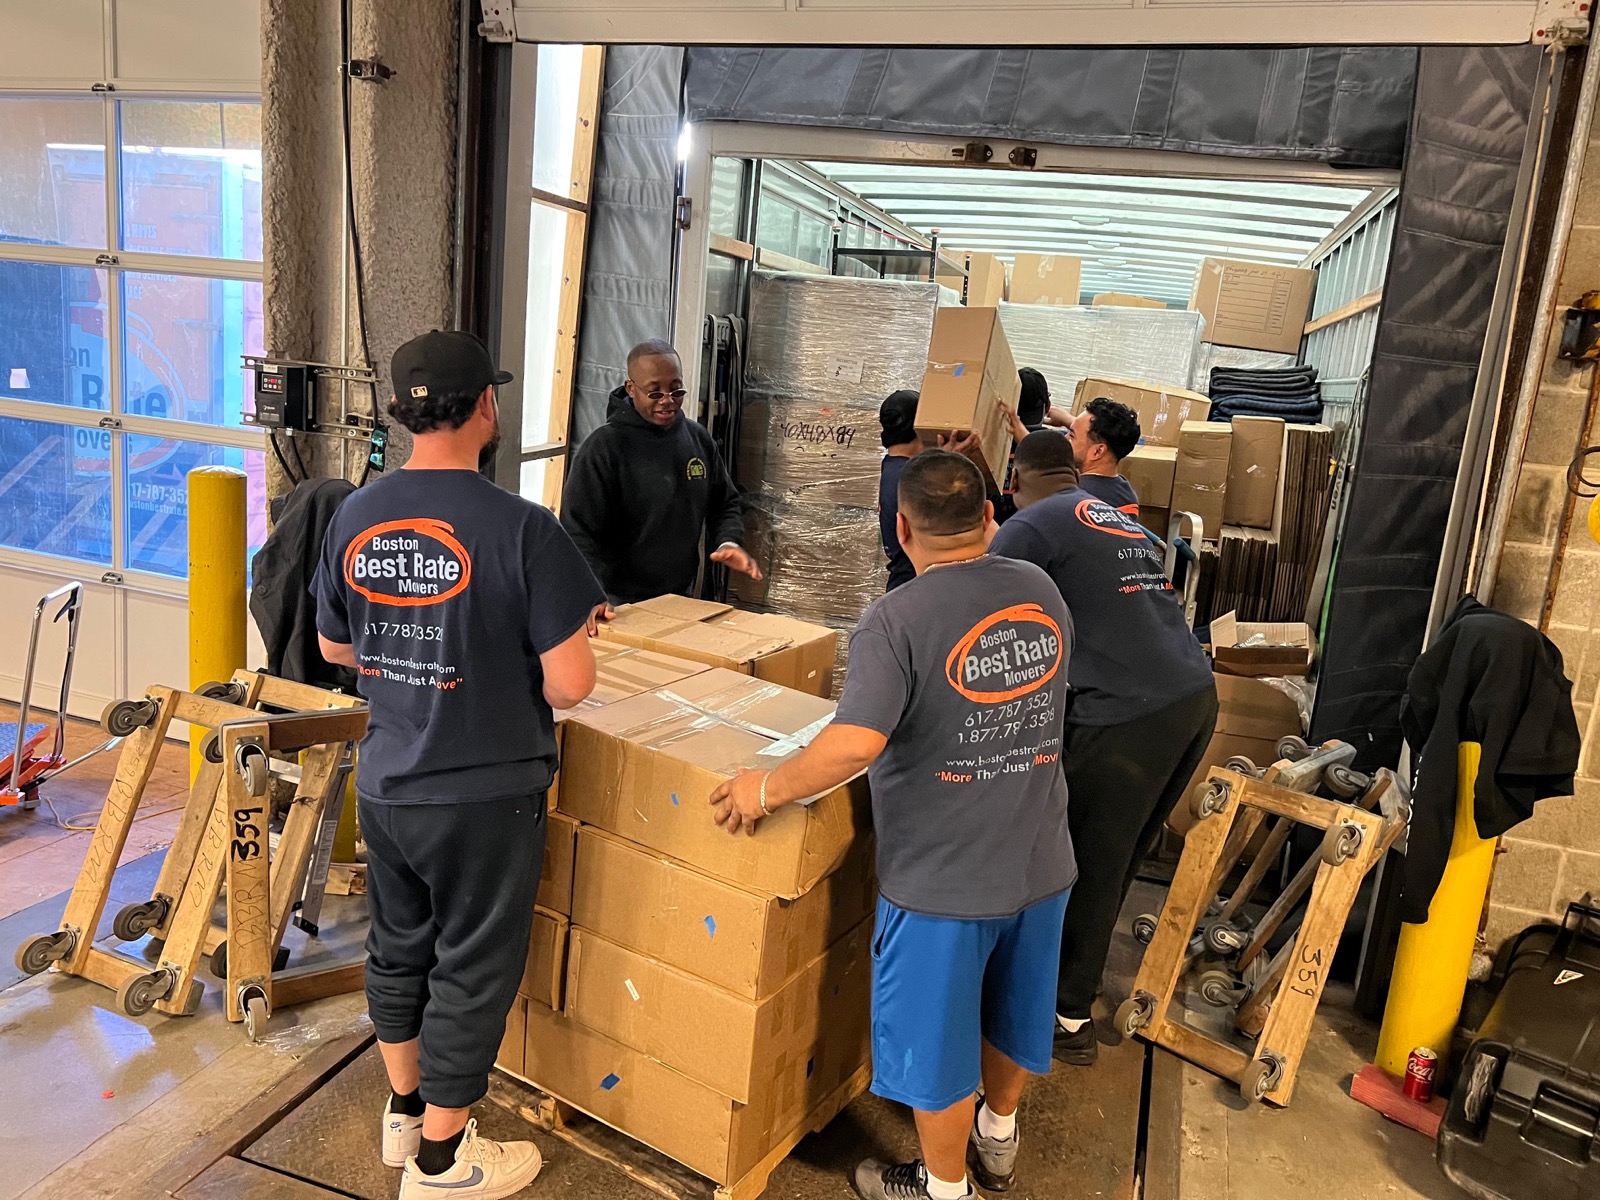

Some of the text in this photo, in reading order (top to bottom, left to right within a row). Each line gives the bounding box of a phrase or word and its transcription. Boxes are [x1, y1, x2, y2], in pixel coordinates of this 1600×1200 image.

[131, 482, 188, 505] 17-787-35
[1087, 510, 1122, 524] Best
[372, 536, 419, 551] Boston
[354, 552, 460, 581] Best Rate
[979, 628, 1018, 649] Boston
[964, 633, 1058, 682] Best Rate
[382, 669, 406, 682] Than
[407, 674, 426, 686] Just
[1004, 664, 1047, 687] Movers
[1002, 761, 1030, 773] Just
[231, 806, 263, 862] 359
[1290, 944, 1322, 999] 359
